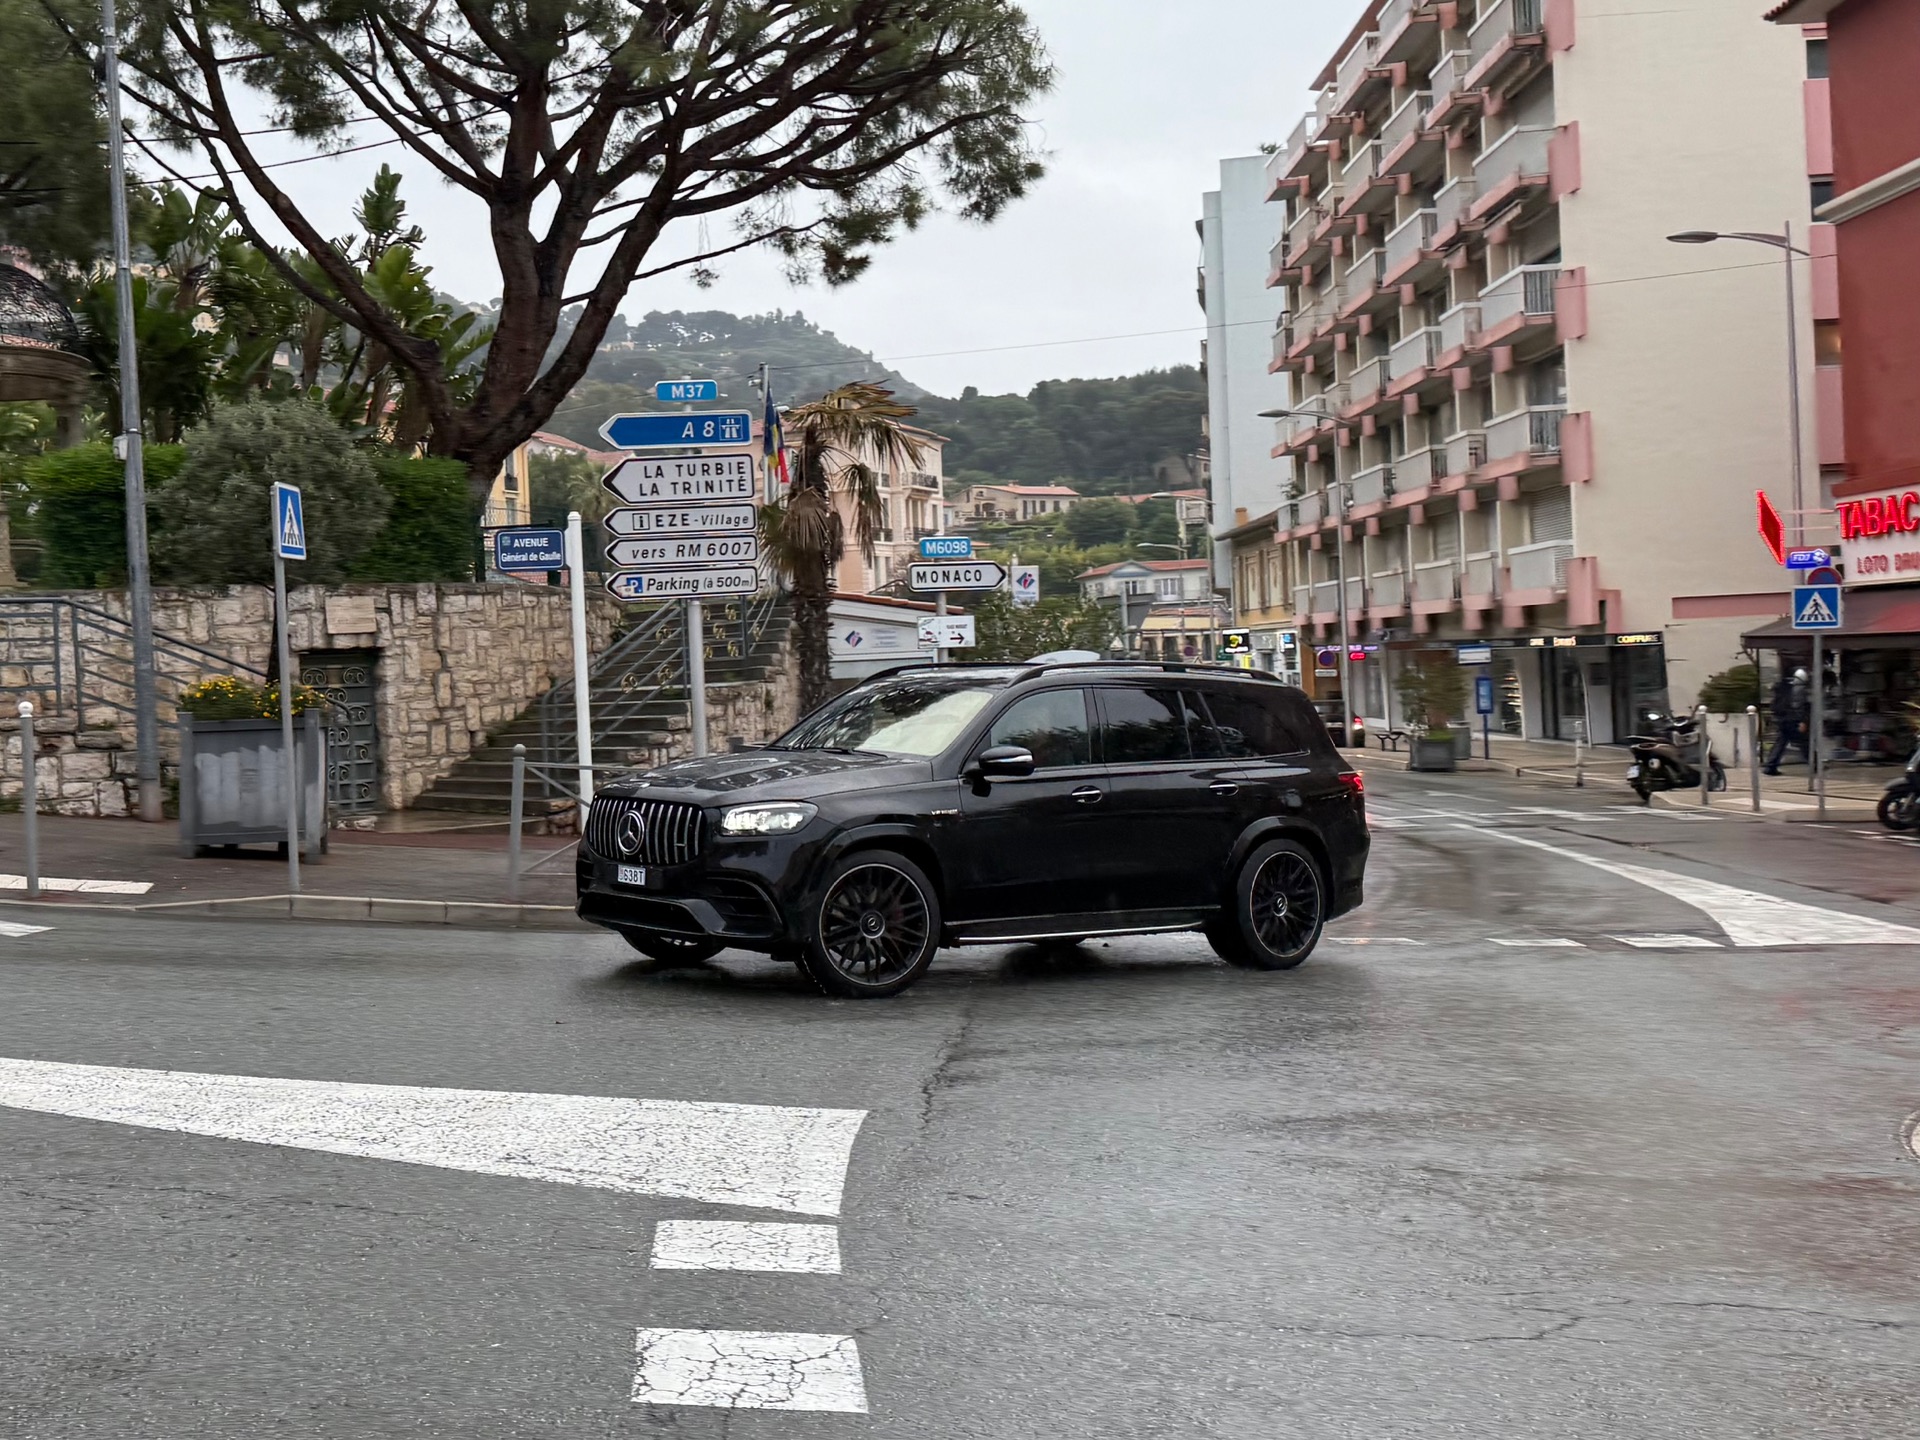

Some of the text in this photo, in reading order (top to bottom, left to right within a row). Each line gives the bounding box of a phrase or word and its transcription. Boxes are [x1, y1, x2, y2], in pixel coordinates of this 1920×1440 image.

[671, 384, 705, 399] M37
[681, 420, 715, 438] A 8
[643, 461, 746, 479] LA TURBIE
[639, 476, 747, 496] LA TRINITÉ
[1835, 491, 1920, 540] TABAC
[513, 537, 549, 548] AVENUE
[632, 541, 752, 559] vers RM 6007
[925, 540, 968, 555] M6098
[501, 551, 562, 562] Général de Gaulle
[1857, 554, 1889, 574] LOTO
[647, 576, 699, 592] Parking
[916, 568, 982, 584] MONACO
